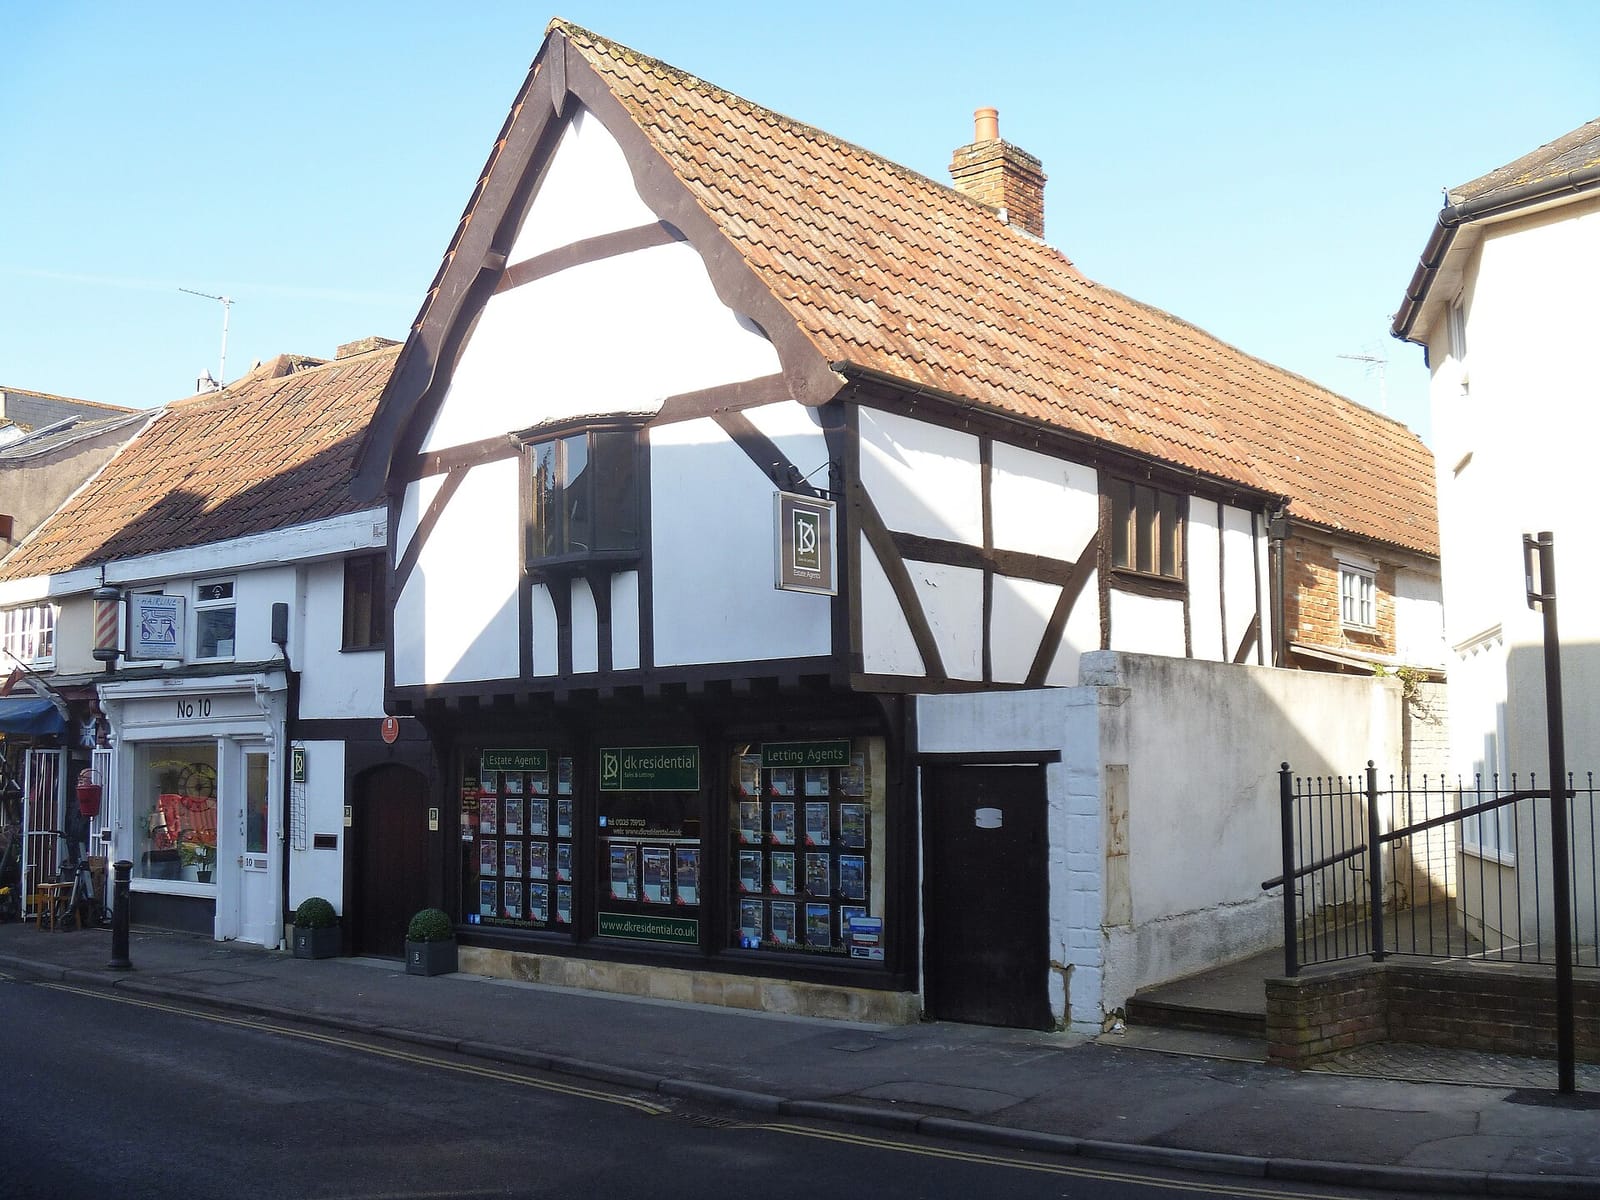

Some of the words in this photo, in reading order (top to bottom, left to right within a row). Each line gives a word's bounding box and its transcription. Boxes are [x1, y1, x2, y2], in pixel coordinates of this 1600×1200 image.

[793, 569, 807, 577] Estate
[807, 571, 820, 579] Agents
[141, 597, 176, 606] HAIRLINE
[177, 700, 193, 718] No
[198, 698, 211, 717] 10
[489, 755, 512, 765] Estate
[514, 756, 541, 767] Agents
[768, 749, 803, 763] Letting
[807, 747, 844, 763] Agents
[246, 858, 252, 867] 10
[600, 921, 695, 937] www.dkresidential.co.uk
